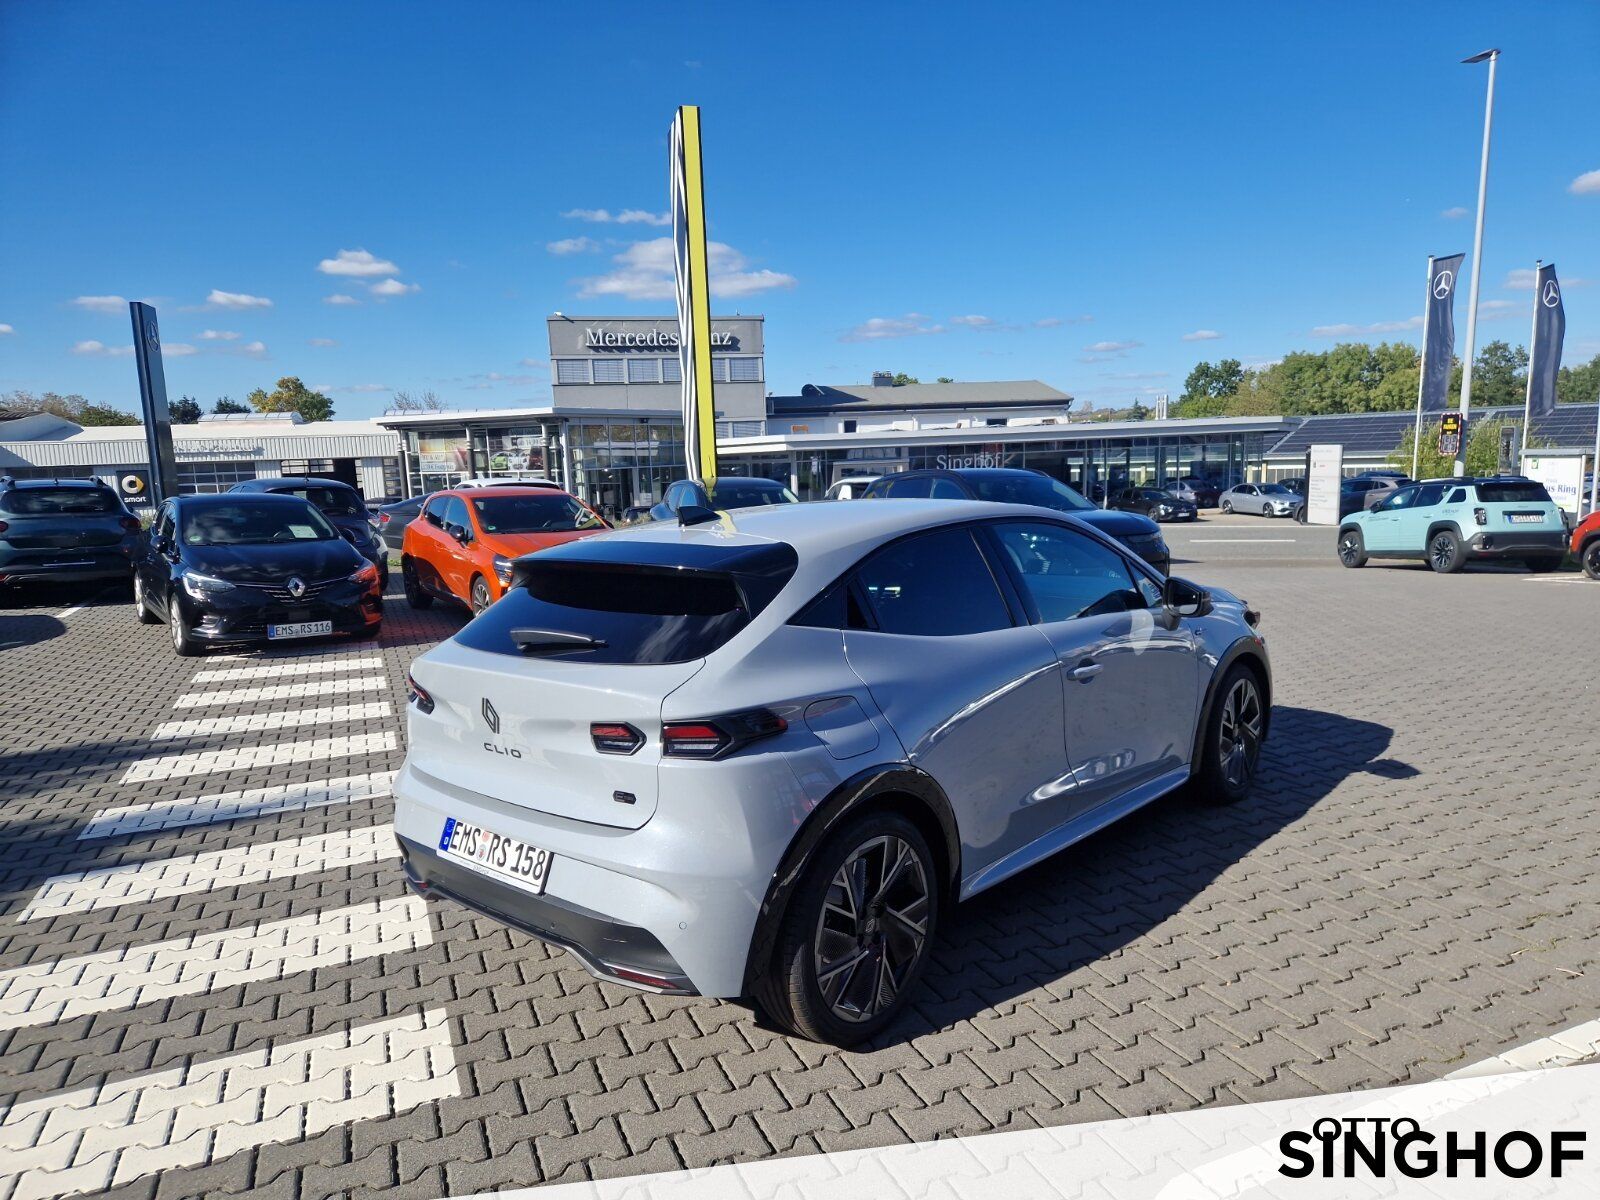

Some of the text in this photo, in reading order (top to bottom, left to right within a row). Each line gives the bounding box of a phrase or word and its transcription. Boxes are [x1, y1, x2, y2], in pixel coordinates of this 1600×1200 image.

[585, 327, 732, 346] Mercedesnz
[936, 451, 1001, 469] Singhof
[275, 622, 331, 636] EMS RS 116
[483, 742, 521, 759] CLIO
[450, 821, 481, 856] EMS
[486, 833, 511, 868] RS
[509, 843, 546, 881] 158
